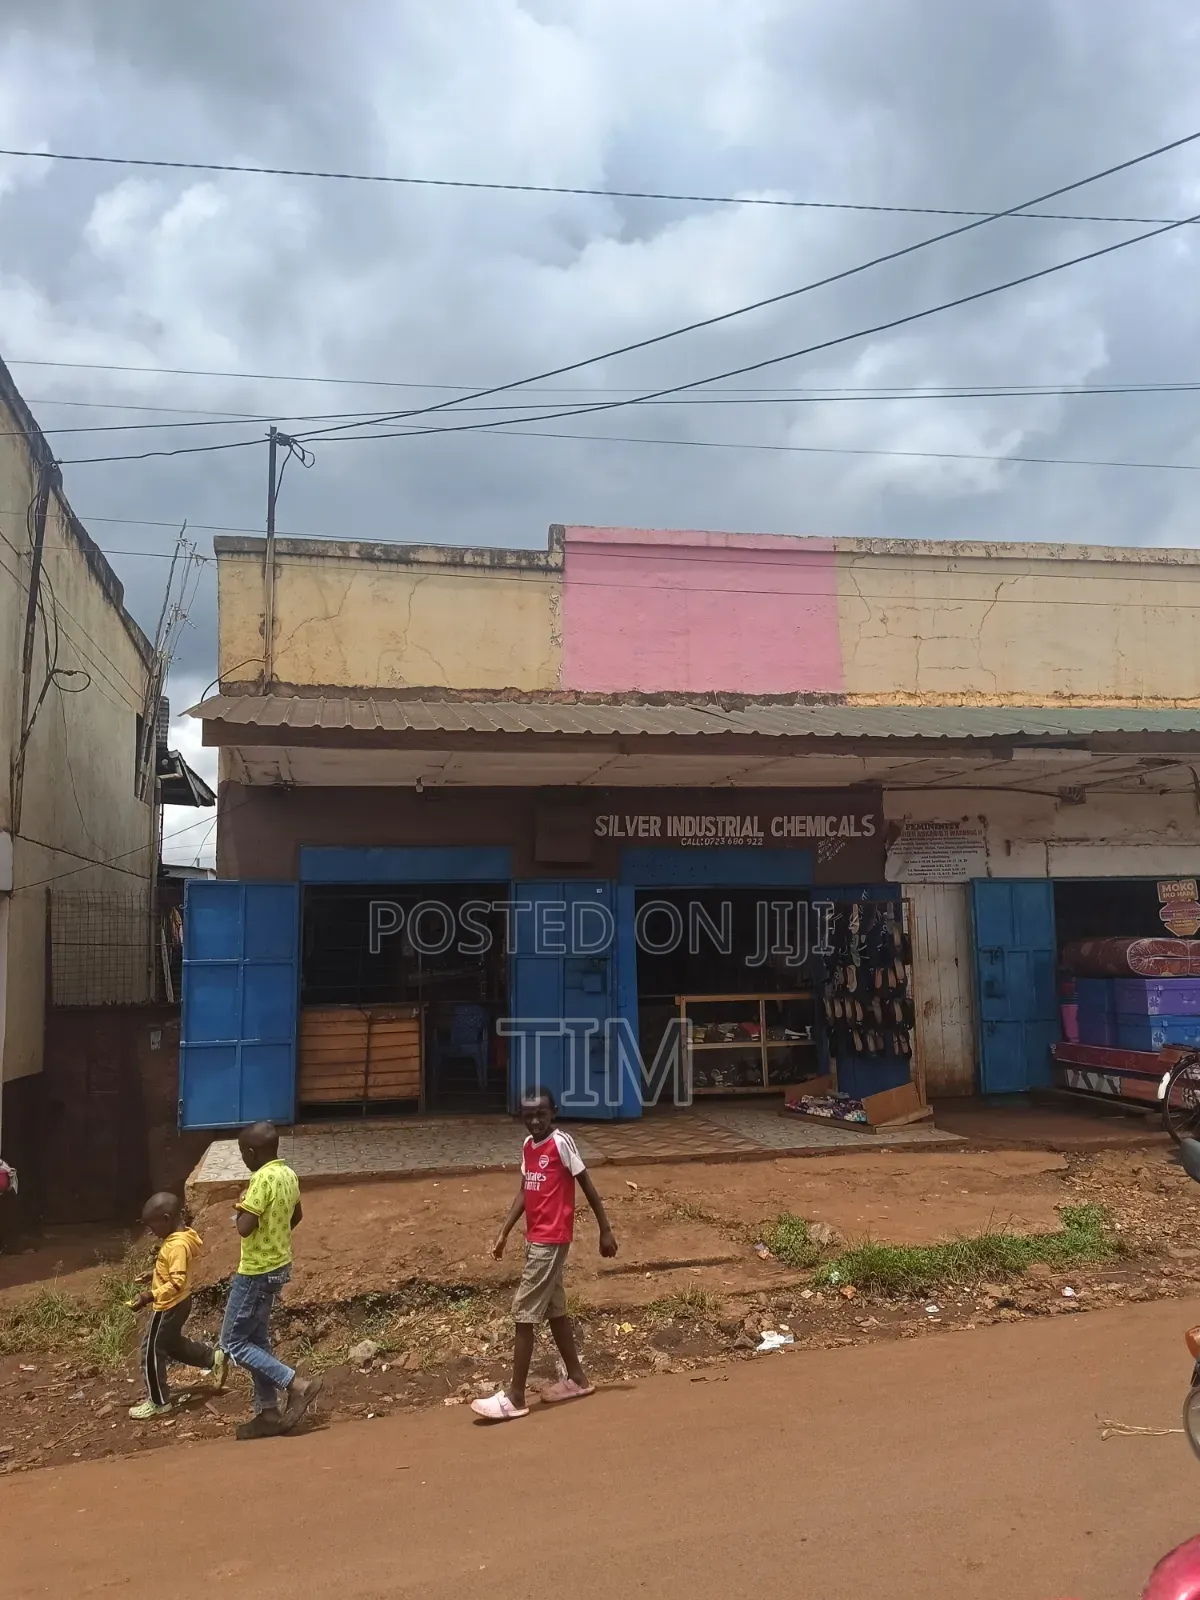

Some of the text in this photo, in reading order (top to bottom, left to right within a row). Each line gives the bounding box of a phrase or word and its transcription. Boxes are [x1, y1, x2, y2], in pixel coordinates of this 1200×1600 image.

[593, 814, 876, 837] SILVER INDUSTRIAL CHEMICALS
[727, 837, 744, 846] 680
[746, 837, 763, 846] 922
[1162, 883, 1194, 892] MOKO
